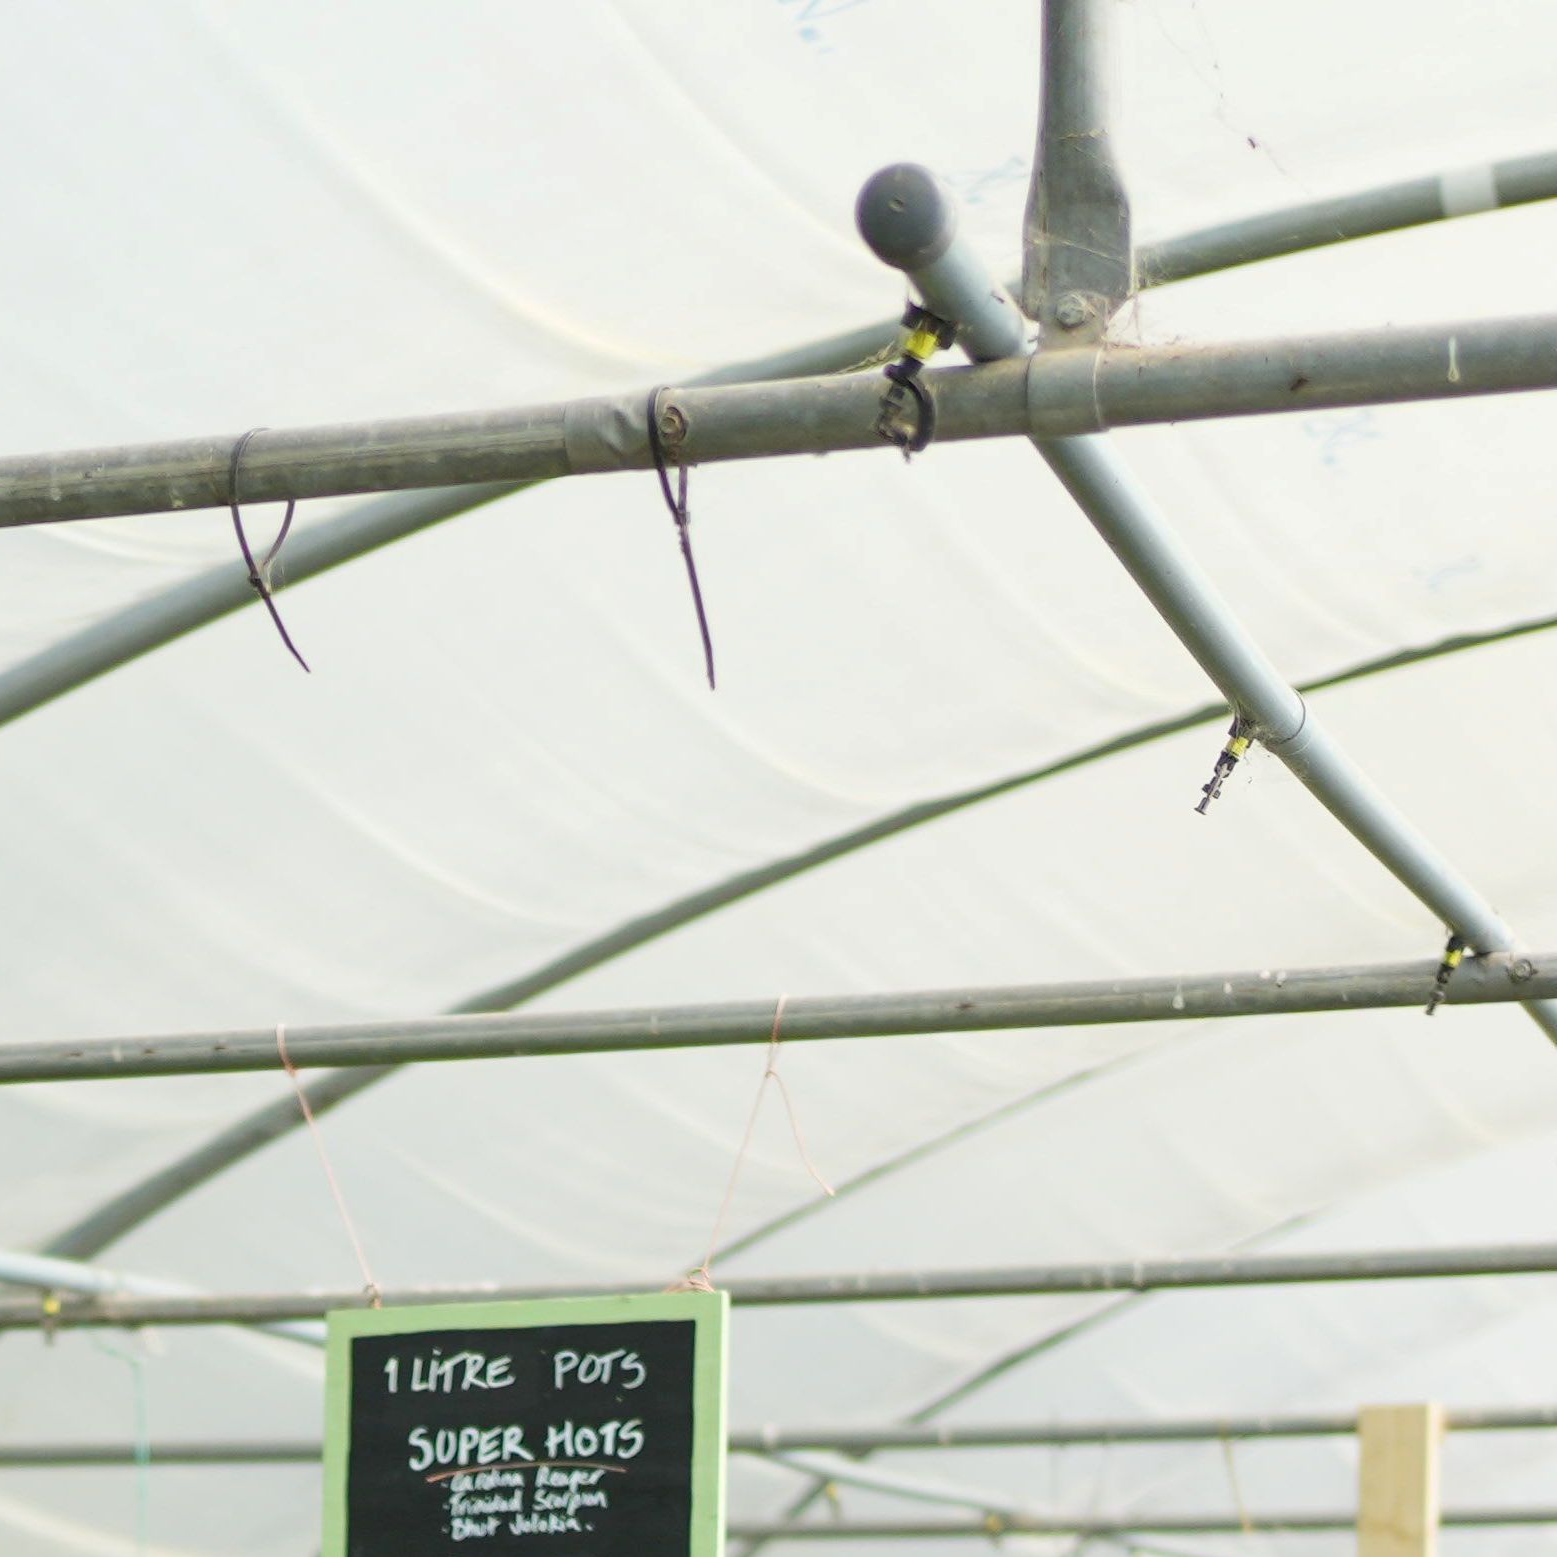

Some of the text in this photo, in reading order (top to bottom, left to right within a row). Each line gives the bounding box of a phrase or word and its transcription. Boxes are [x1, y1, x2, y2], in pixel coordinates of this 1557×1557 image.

[384, 1357, 398, 1392] 1
[554, 1350, 648, 1390] POTS
[408, 1419, 644, 1471] SUPER HOTS
